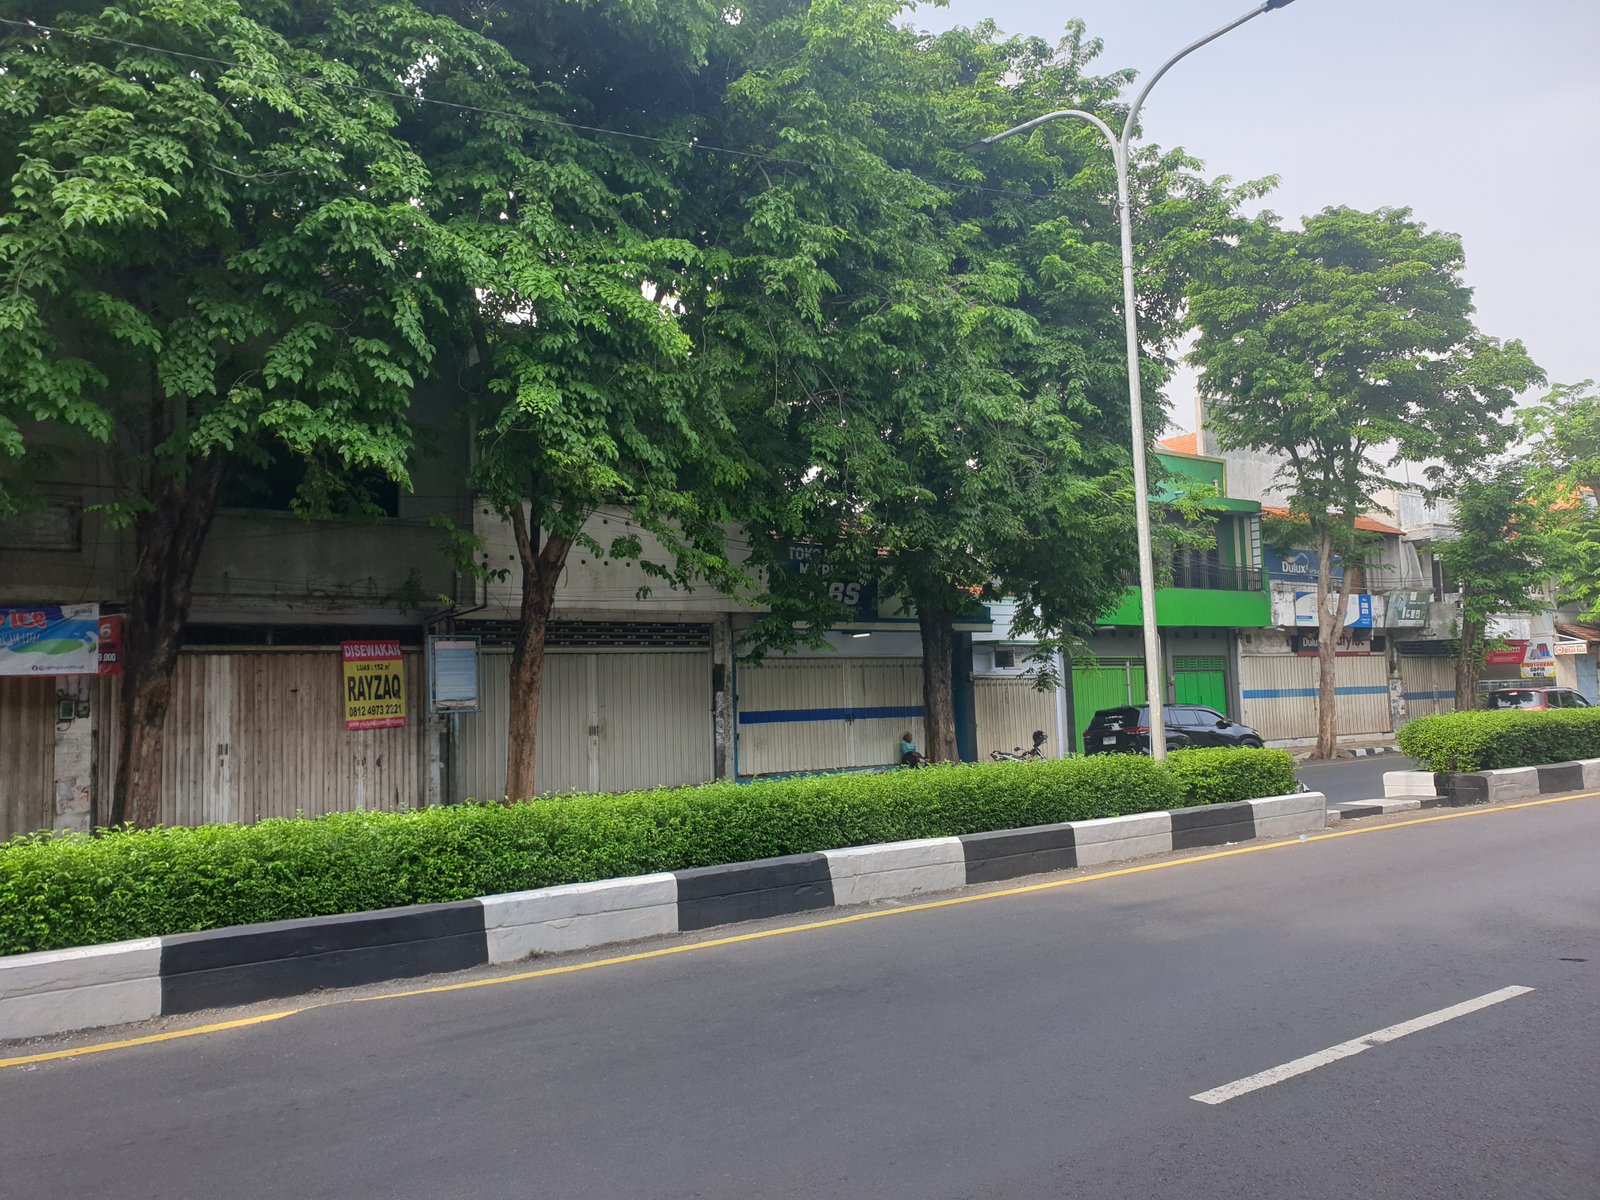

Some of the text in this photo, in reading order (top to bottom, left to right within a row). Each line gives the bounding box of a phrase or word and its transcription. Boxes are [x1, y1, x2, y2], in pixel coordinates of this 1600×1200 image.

[1282, 561, 1307, 574] Dulux
[1303, 637, 1319, 647] Dulu
[345, 645, 401, 657] DISEWAKAN
[347, 674, 402, 702] RAYZAQ
[349, 705, 366, 717] 0812
[367, 704, 384, 716] 4973
